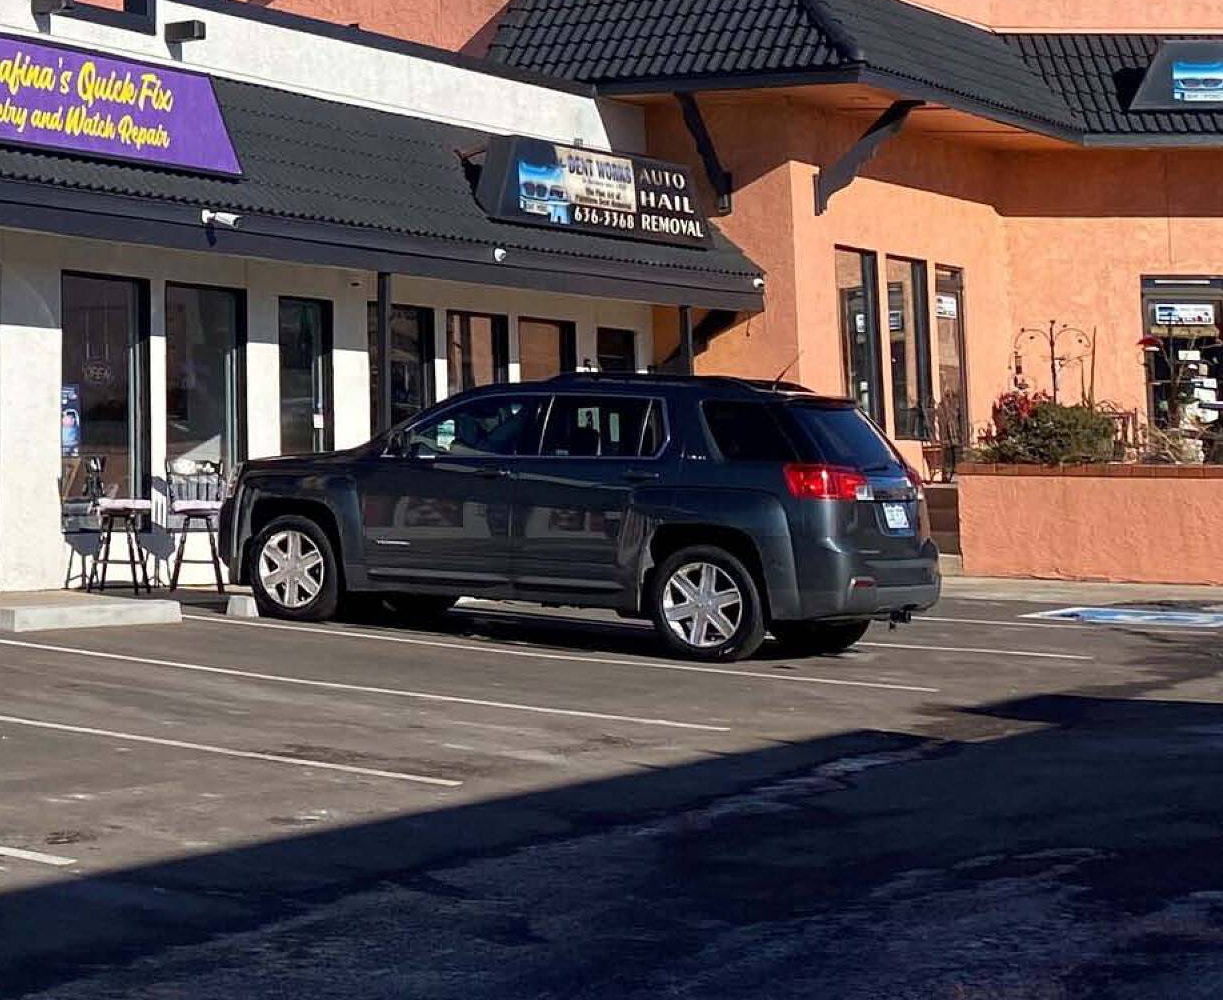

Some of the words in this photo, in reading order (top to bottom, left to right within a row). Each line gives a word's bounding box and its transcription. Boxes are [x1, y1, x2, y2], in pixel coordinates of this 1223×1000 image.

[78, 61, 136, 107] Quick
[137, 72, 174, 112] Fix
[30, 106, 64, 132] and
[64, 105, 115, 139] Watch
[117, 114, 171, 150] Repair
[639, 168, 685, 190] AUTO
[640, 190, 695, 214] HAIL
[574, 206, 635, 230] 636-3368
[641, 213, 704, 238] REMOVAL
